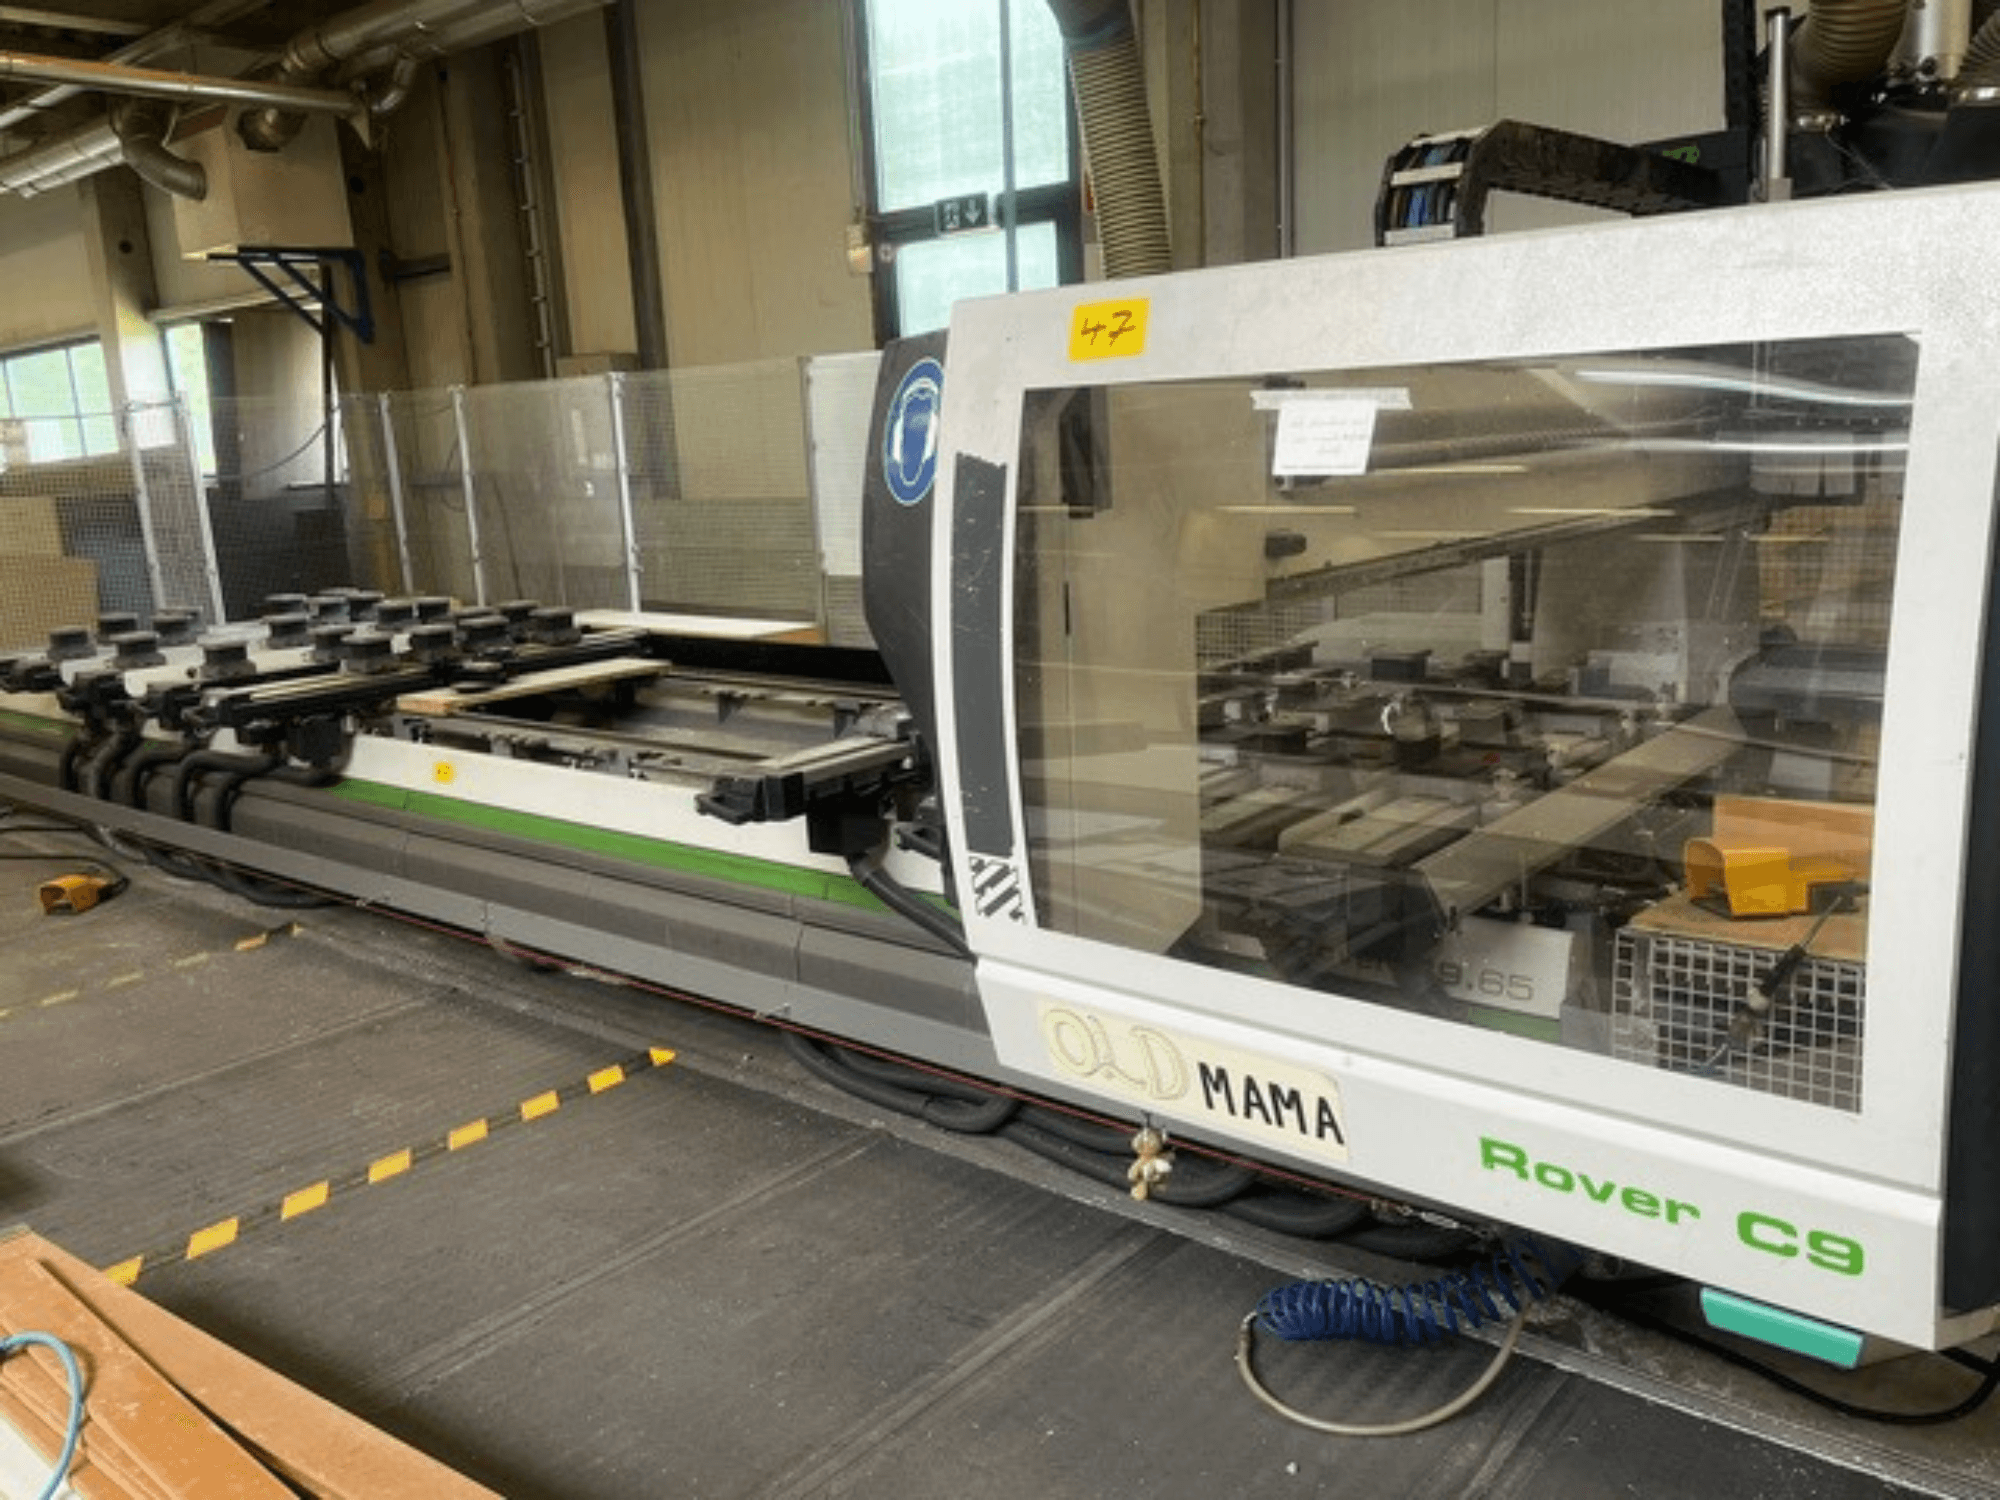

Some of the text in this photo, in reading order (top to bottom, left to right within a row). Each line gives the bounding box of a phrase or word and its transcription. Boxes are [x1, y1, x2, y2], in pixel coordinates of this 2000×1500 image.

[1081, 309, 1136, 347] 47
[1045, 1008, 1344, 1145] OLD MAMA
[1480, 1136, 1865, 1277] Rover C9
